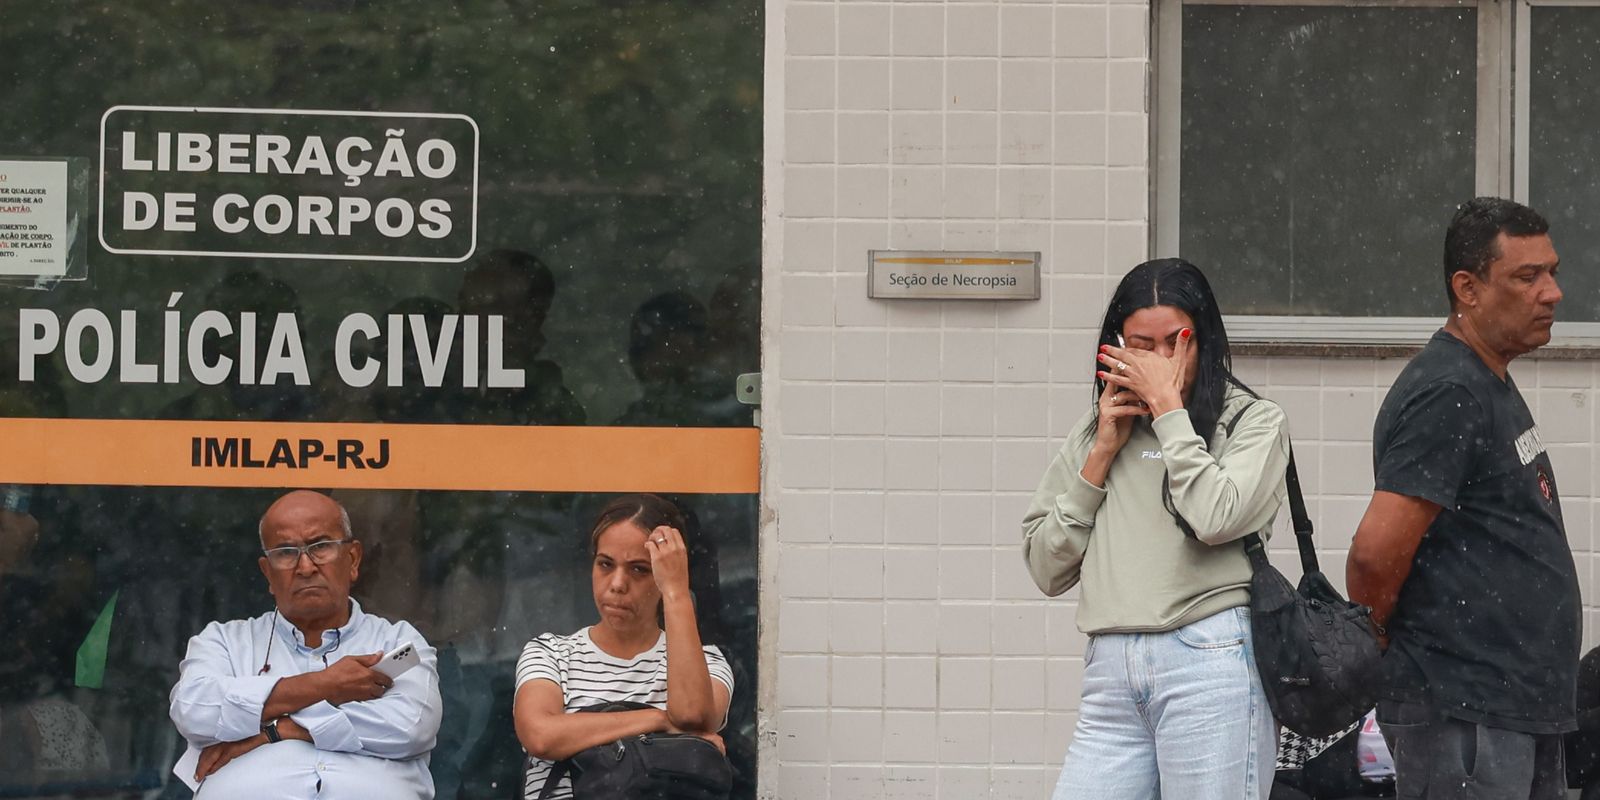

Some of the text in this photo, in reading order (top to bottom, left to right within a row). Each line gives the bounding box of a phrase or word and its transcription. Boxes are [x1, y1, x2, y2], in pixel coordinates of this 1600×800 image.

[122, 129, 457, 186] LIBERAÇÃO
[122, 191, 453, 239] DE CORPOS
[889, 273, 1017, 289] Seção de Necropsia
[18, 292, 526, 389] POLÍCIA CIVIL
[191, 436, 391, 470] IMLAP-RJ
[1141, 451, 1162, 459] FILA
